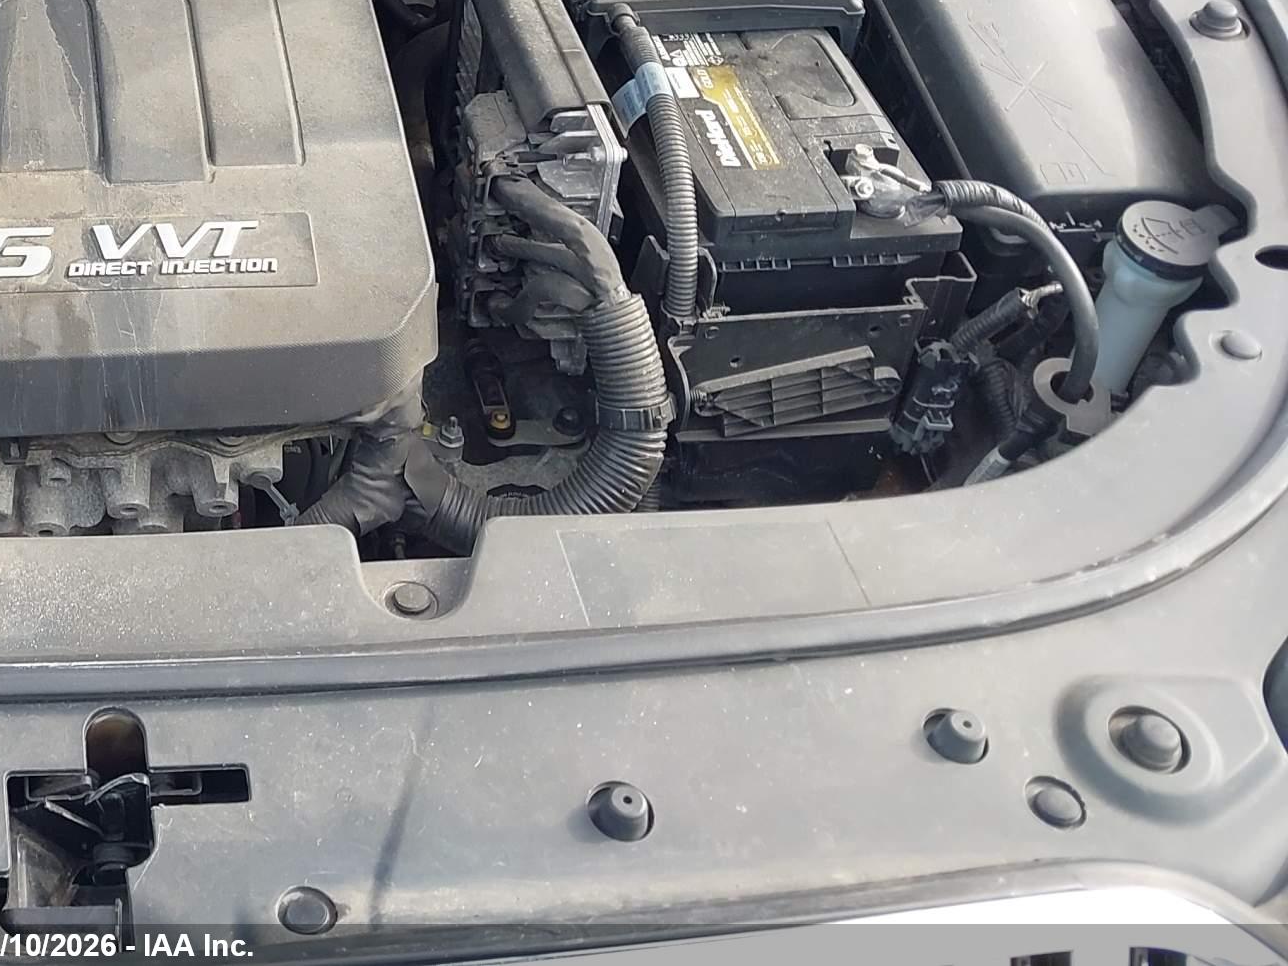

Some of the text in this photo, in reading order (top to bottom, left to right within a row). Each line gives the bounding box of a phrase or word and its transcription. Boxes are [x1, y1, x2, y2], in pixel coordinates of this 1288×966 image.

[695, 109, 742, 167] DieHard
[89, 220, 259, 261] VVT
[68, 257, 279, 278] DIRECT INJECTION
